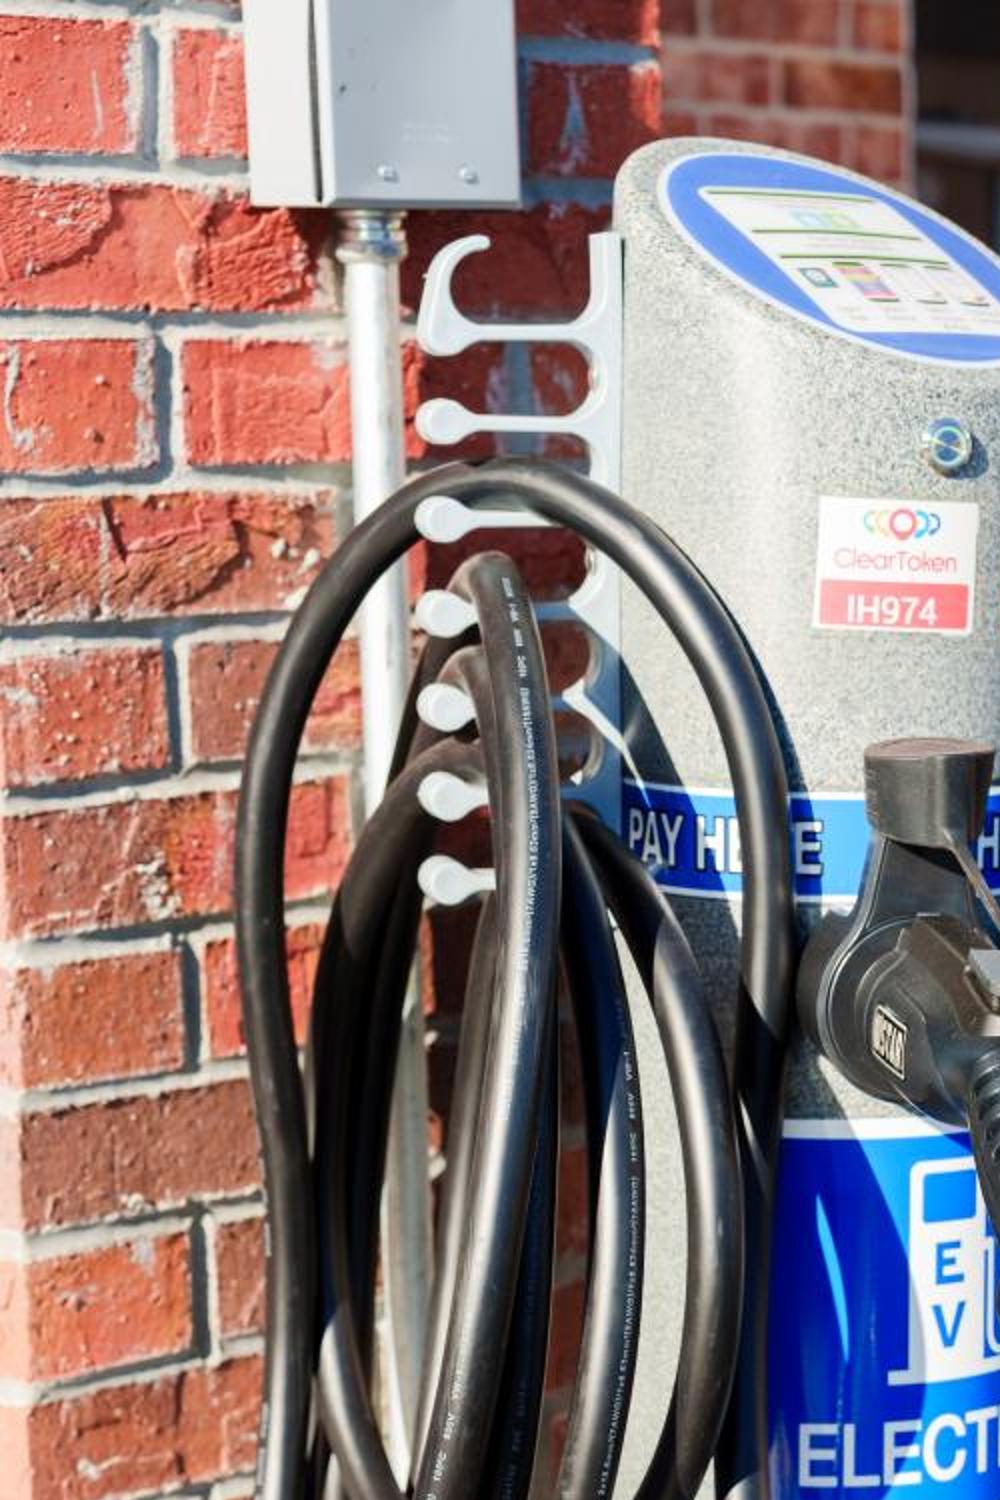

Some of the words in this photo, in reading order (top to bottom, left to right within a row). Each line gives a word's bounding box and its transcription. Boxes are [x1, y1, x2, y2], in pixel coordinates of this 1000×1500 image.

[832, 547, 957, 574] ClearToken
[847, 594, 938, 627] IH974
[629, 808, 683, 867] PAY
[697, 815, 823, 876] HE
